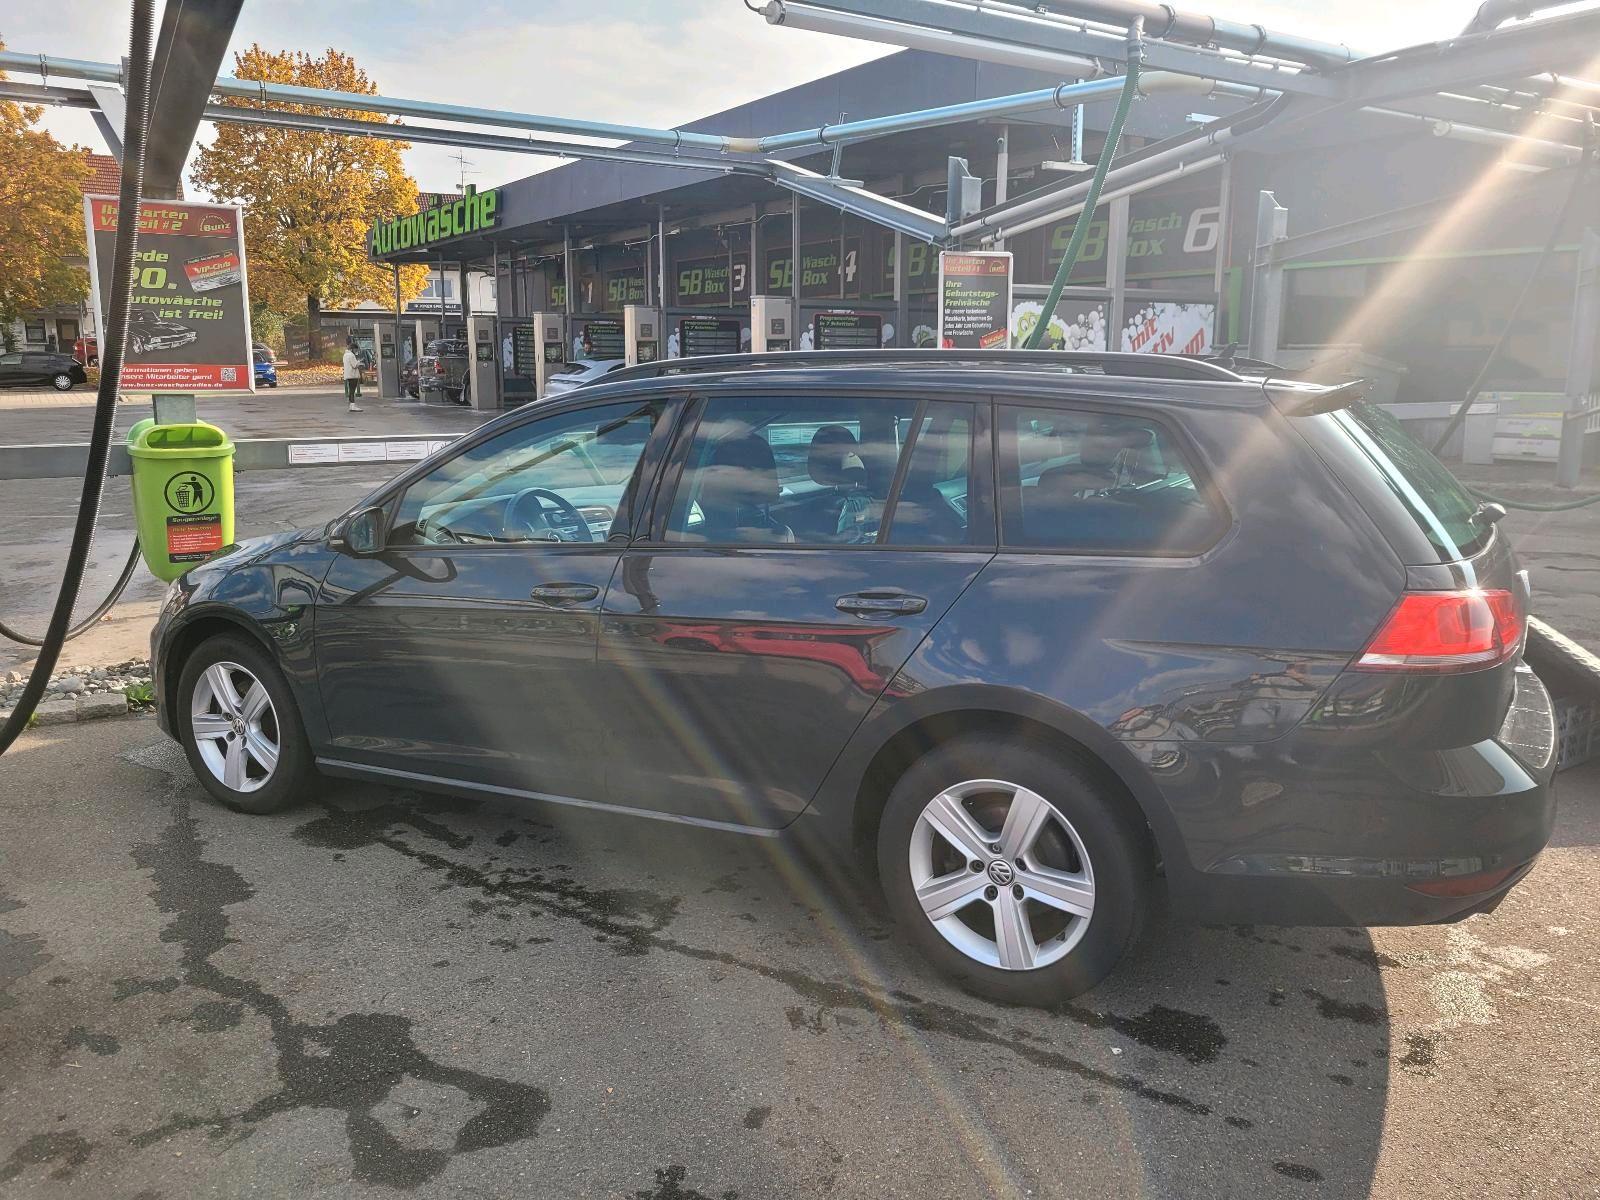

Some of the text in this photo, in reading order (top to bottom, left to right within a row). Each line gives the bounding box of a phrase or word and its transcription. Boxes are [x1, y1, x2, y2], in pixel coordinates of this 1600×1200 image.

[138, 209, 189, 220] arten
[370, 184, 497, 256] Autowäsche
[203, 222, 231, 232] Bunz
[1183, 206, 1221, 253] 6
[134, 250, 170, 263] ede
[802, 254, 837, 268] Wasch
[838, 250, 857, 283] 4
[679, 264, 747, 297] SB Wasch 3
[802, 270, 829, 287] Box
[608, 279, 627, 302] SB
[704, 280, 725, 294] Box
[130, 295, 223, 307] utowäsche
[945, 299, 991, 307] Freiwäsche
[159, 308, 224, 320] ist frei!
